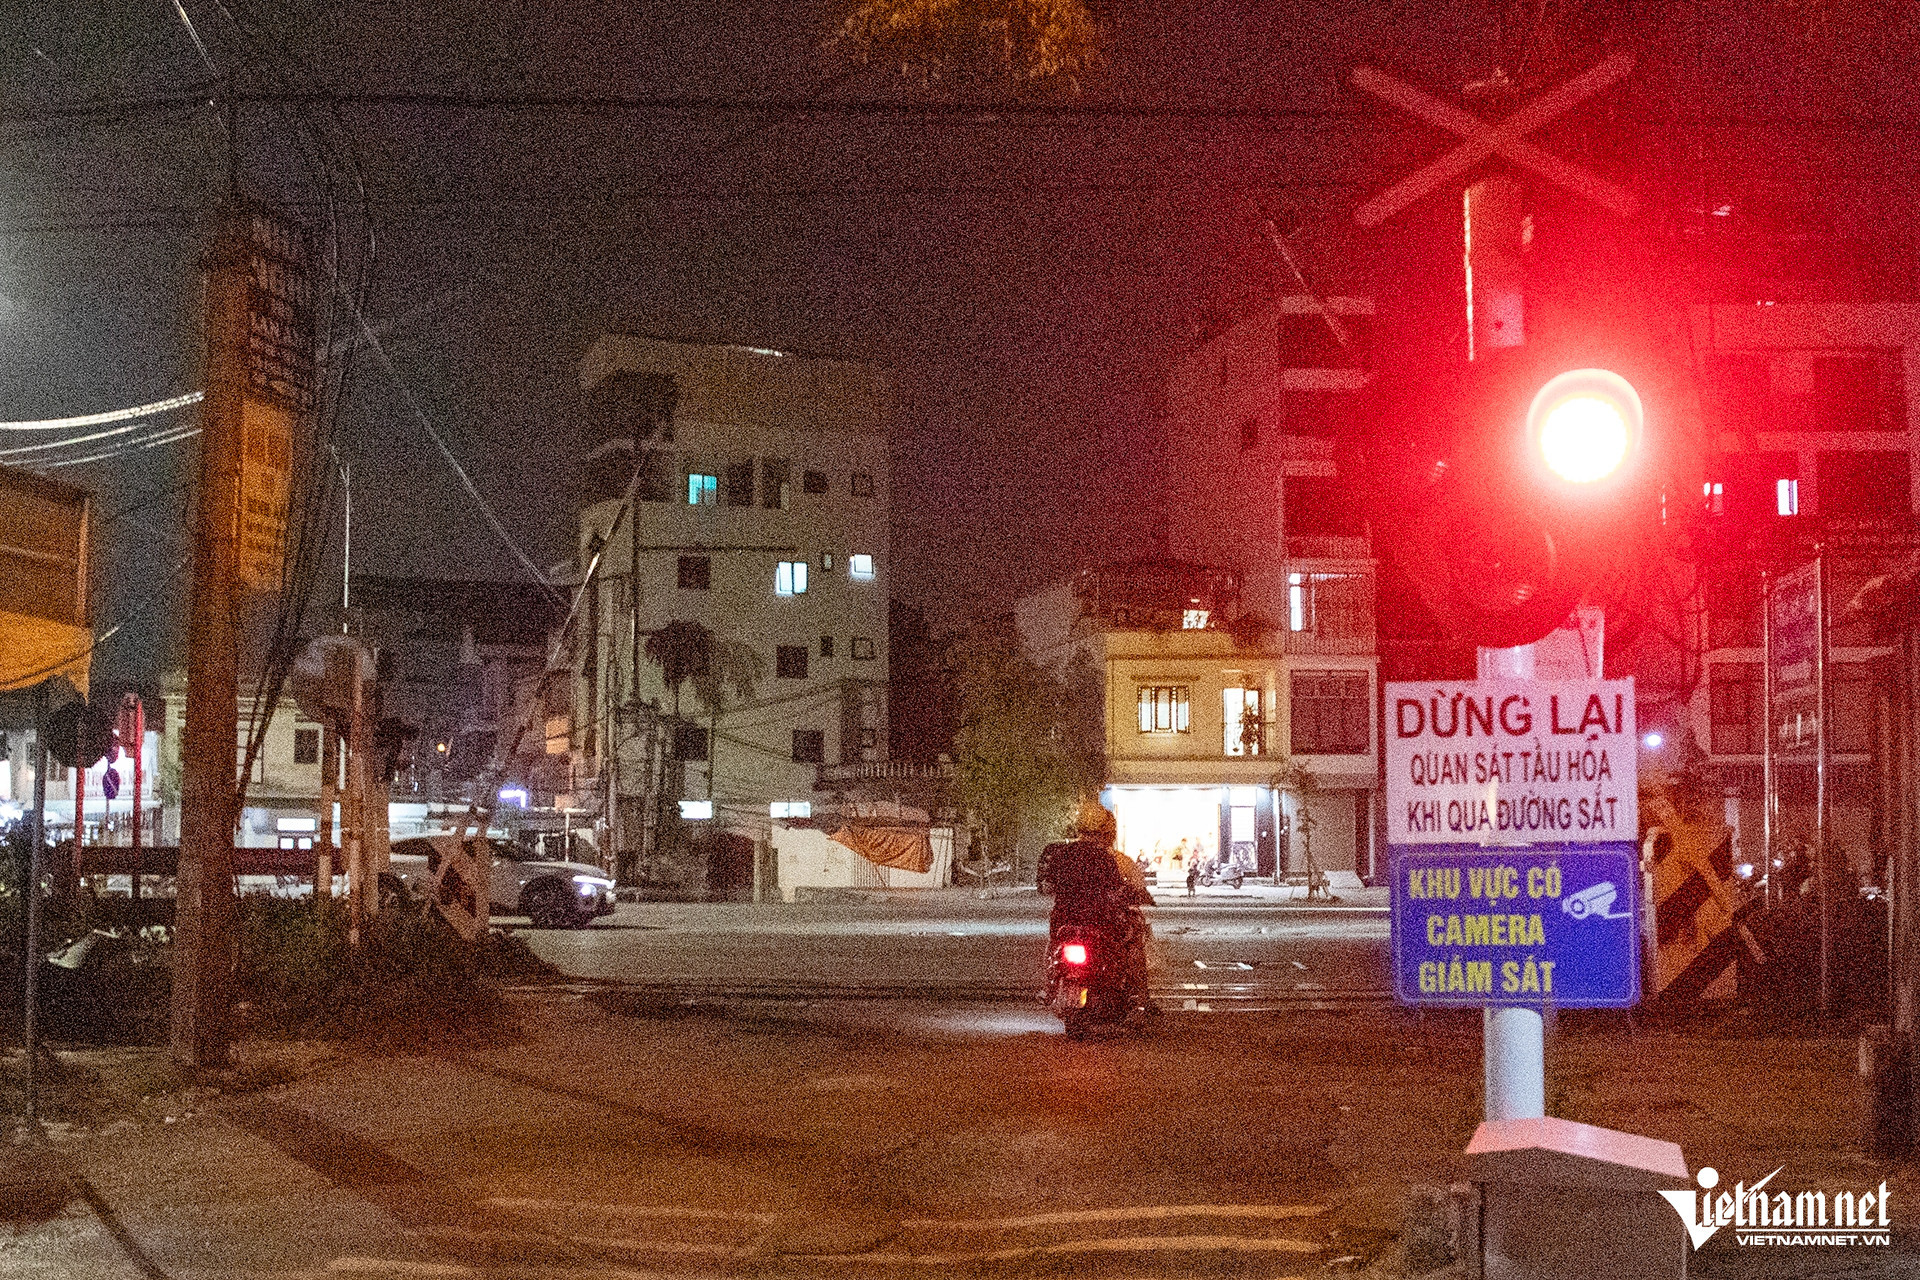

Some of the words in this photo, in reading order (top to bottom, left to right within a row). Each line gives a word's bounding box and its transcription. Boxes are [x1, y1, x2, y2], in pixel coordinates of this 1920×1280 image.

[1396, 689, 1533, 738] DỪNG
[1550, 693, 1624, 741] LẠI
[1410, 752, 1468, 786] QUAN
[1475, 742, 1514, 784] SÁT
[1407, 800, 1441, 832] KHI
[1448, 798, 1494, 833] QUA
[1496, 789, 1572, 831] ĐƯỜNG
[1408, 867, 1461, 899] KHU
[1468, 862, 1519, 906] VỰC
[1526, 859, 1562, 899] CÓ
[1426, 913, 1546, 946] CAMERA
[1418, 954, 1493, 993] GIÁM
[1500, 954, 1556, 993] SÁT
